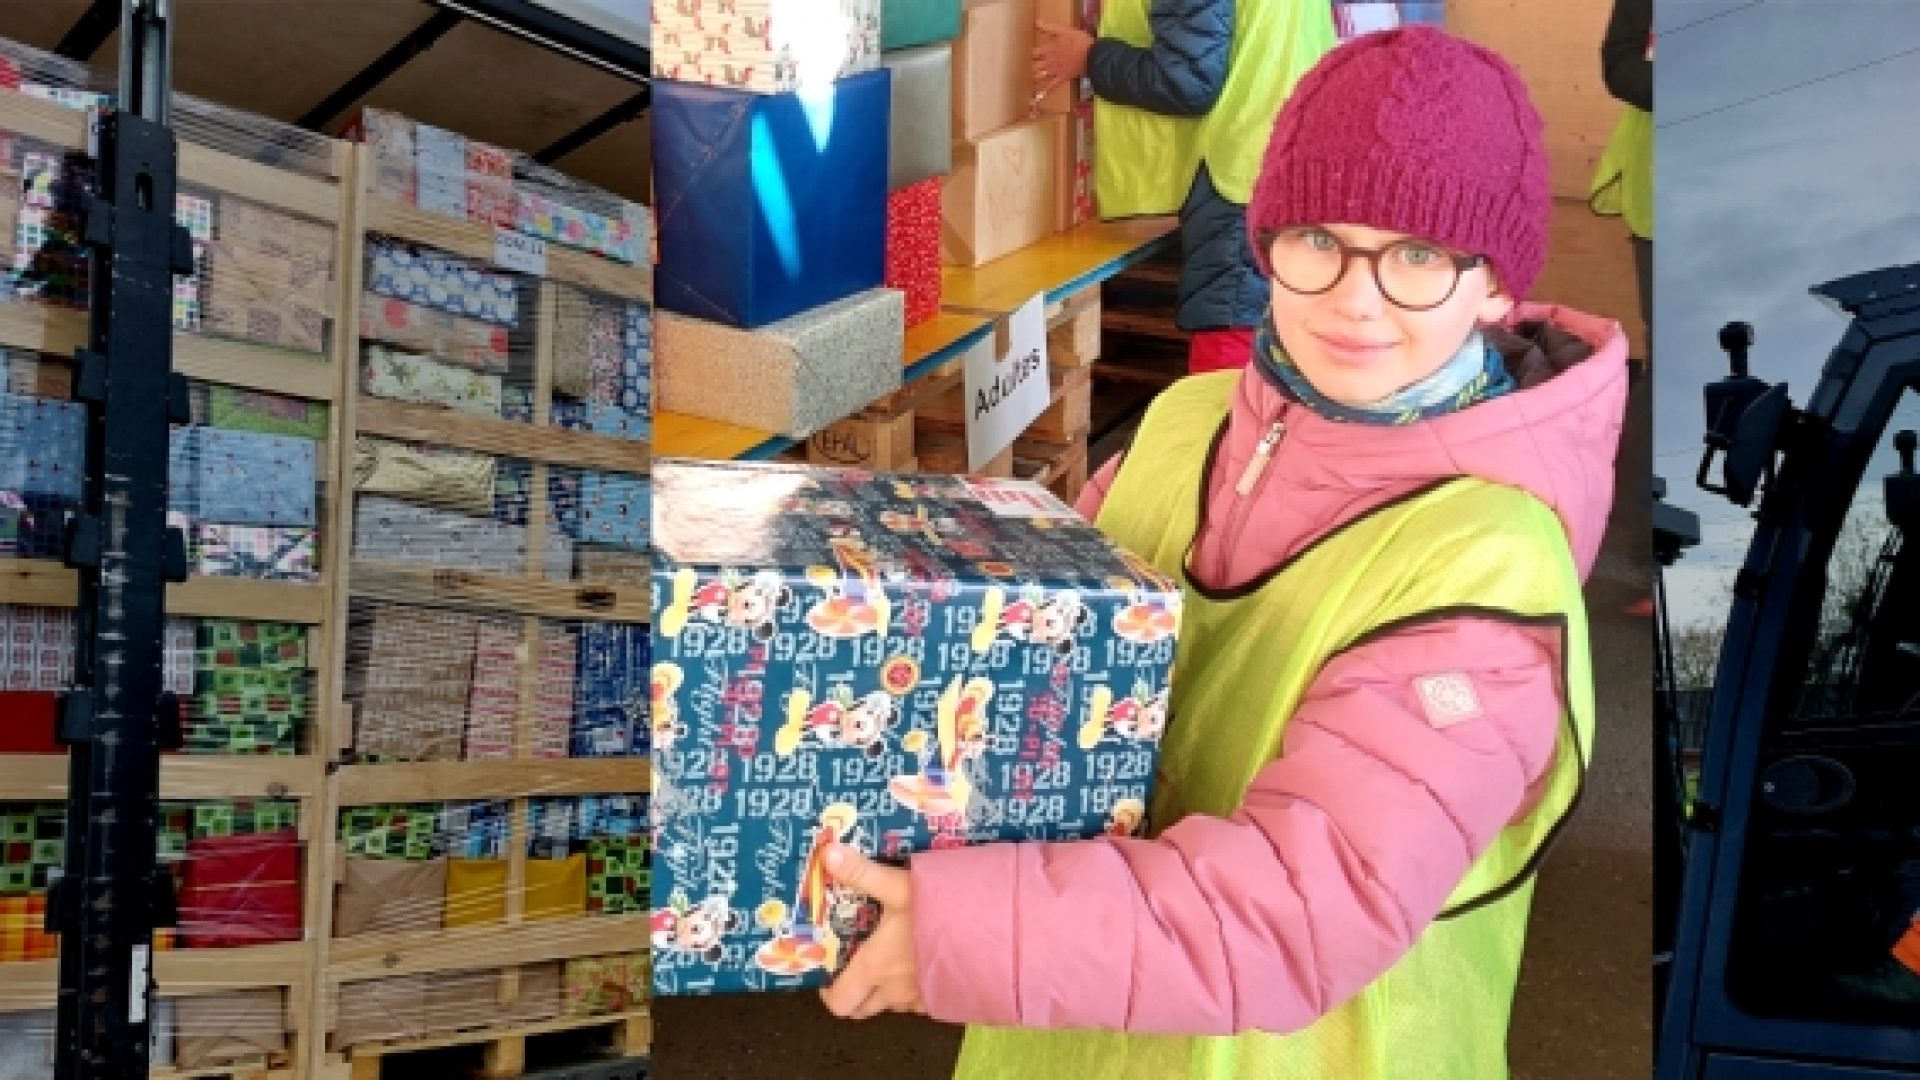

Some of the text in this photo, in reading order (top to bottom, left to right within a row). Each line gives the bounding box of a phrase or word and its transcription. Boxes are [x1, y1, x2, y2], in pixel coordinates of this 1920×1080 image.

[671, 624, 746, 658] 1928
[1105, 638, 1173, 668] 1928
[995, 678, 1027, 756] 1928
[741, 751, 818, 783] 1928
[831, 755, 904, 787] 1928
[1000, 761, 1072, 791] 1928
[1085, 750, 1152, 782] 1928
[734, 787, 813, 819] 1928
[996, 794, 1066, 824] 1928
[754, 818, 794, 900] Fligh
